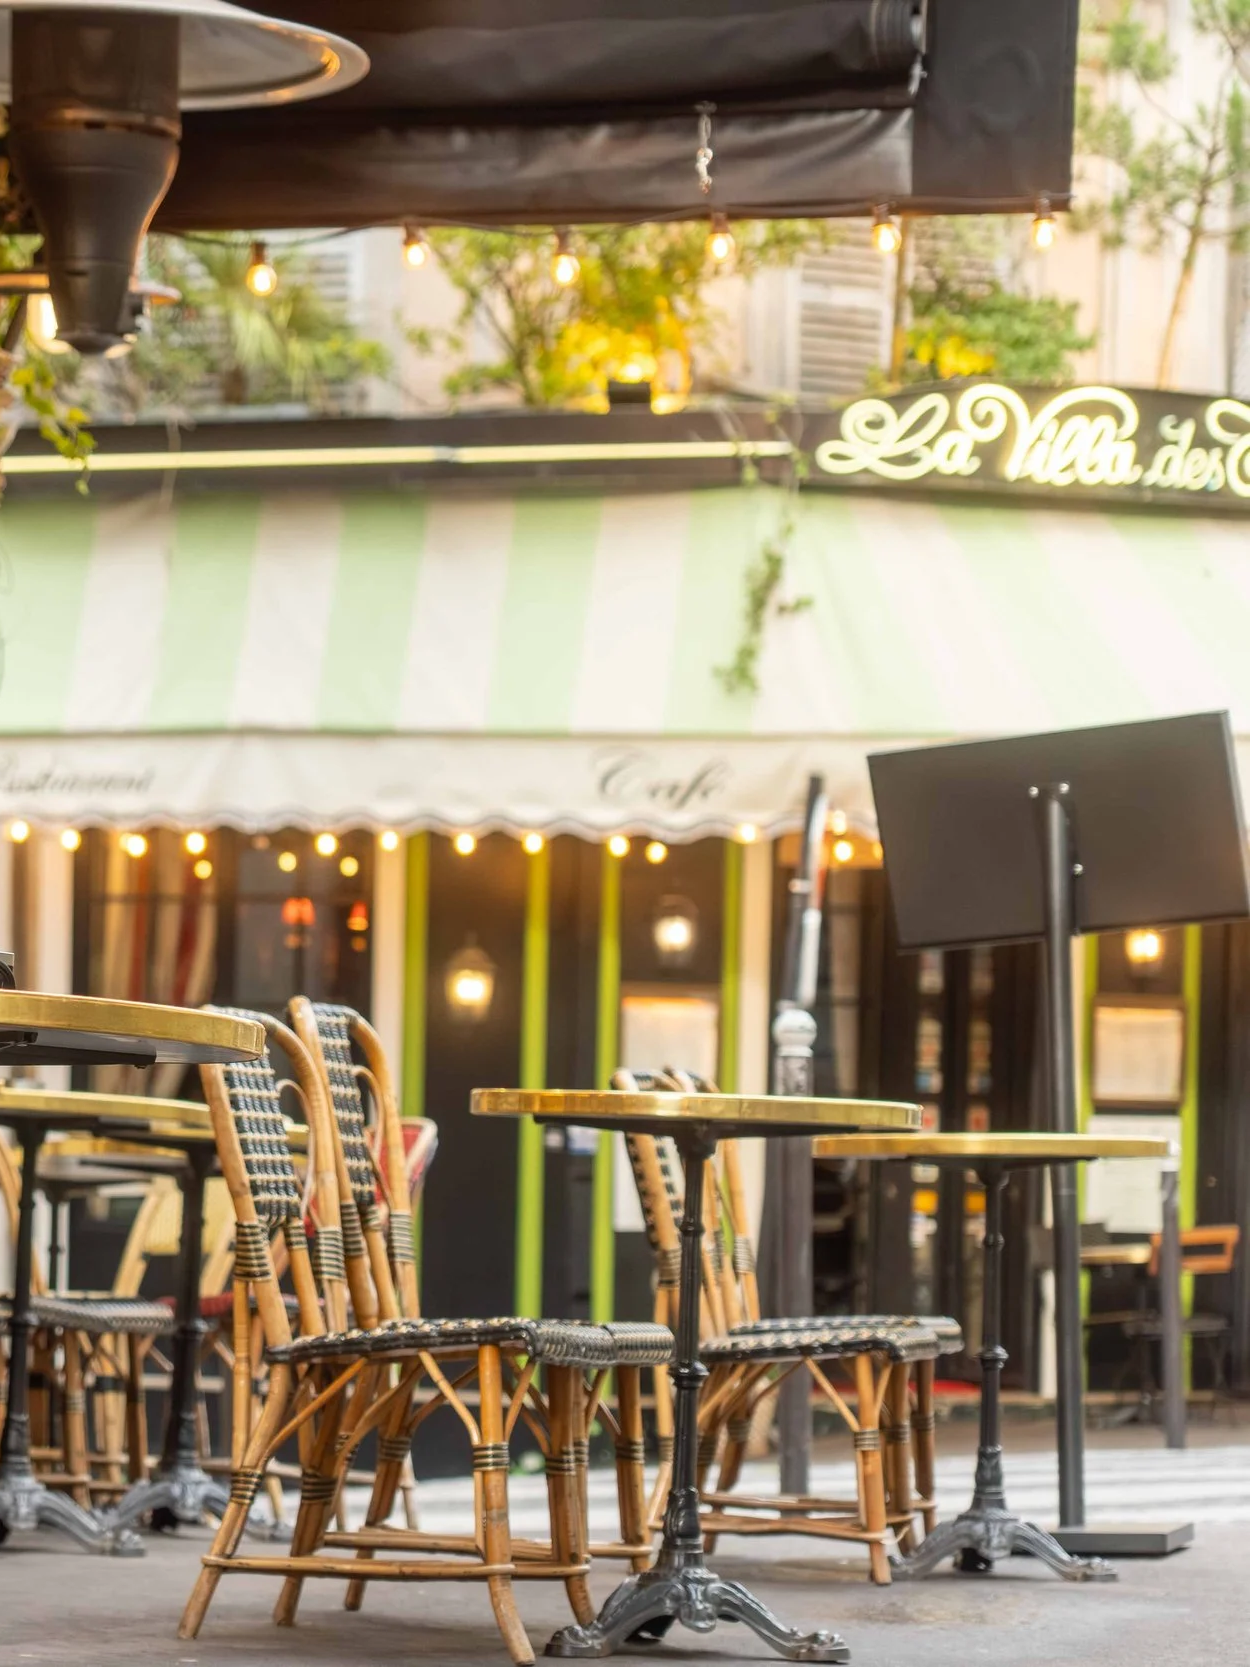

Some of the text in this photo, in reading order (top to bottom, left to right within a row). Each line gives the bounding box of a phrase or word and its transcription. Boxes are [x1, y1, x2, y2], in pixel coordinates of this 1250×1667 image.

[815, 392, 982, 481] La
[956, 383, 1144, 487] Villa
[1141, 413, 1226, 492] des
